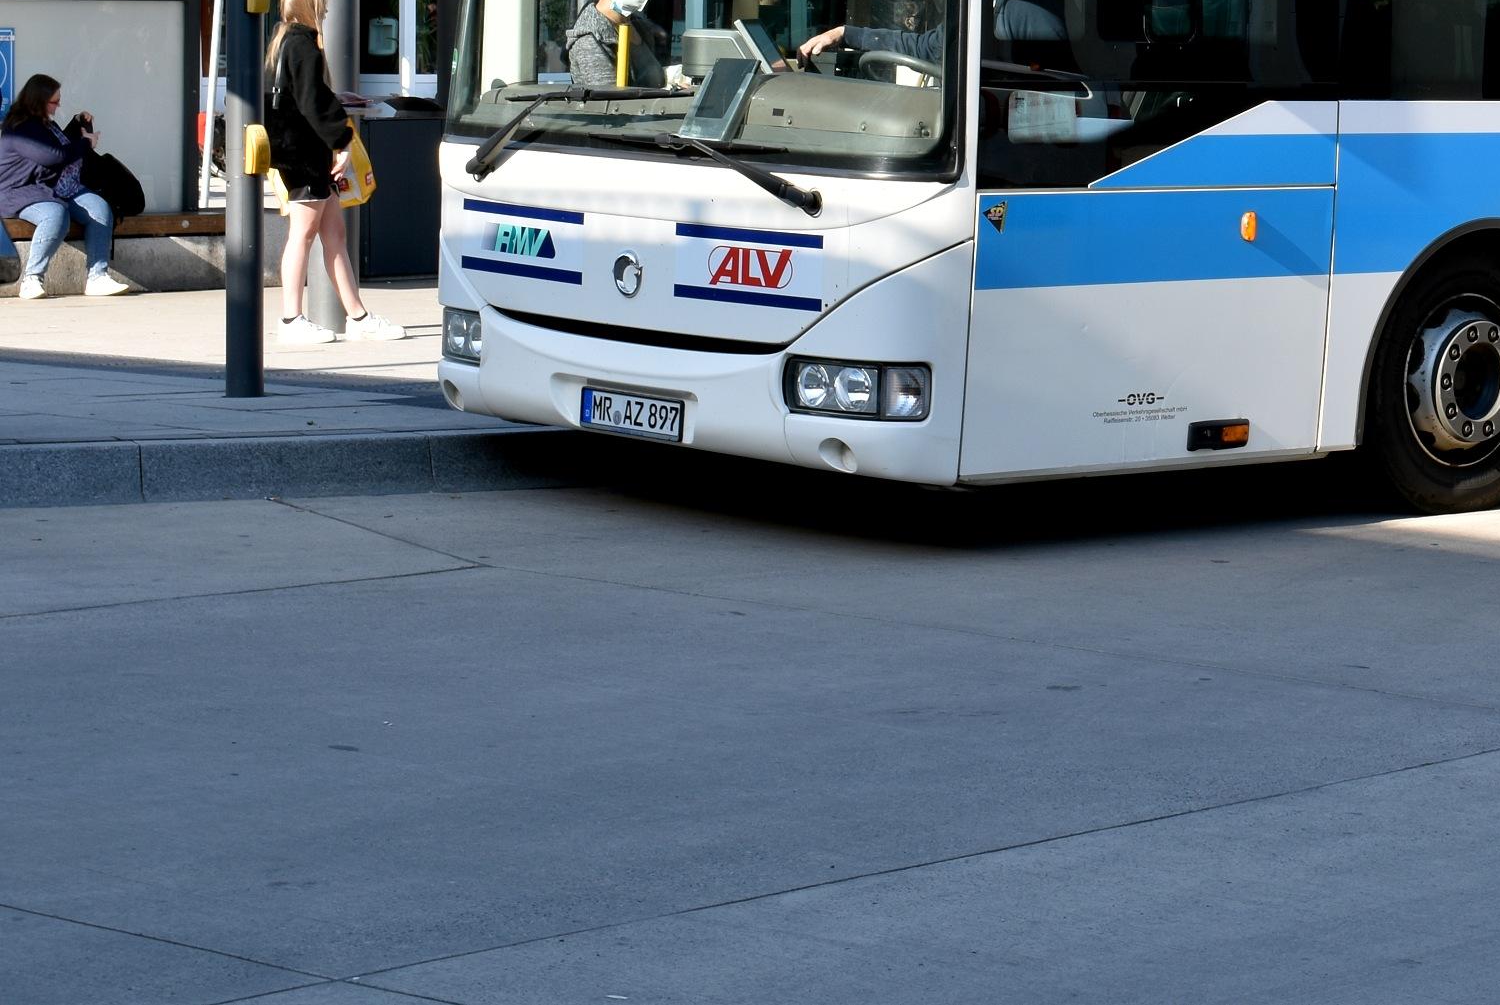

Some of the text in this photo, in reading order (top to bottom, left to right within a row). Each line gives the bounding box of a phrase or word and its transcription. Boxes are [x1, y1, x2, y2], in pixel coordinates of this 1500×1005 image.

[494, 223, 793, 288] RMV ALV
[593, 394, 613, 422] MR
[623, 399, 645, 428] AZ
[648, 403, 680, 432] 897
